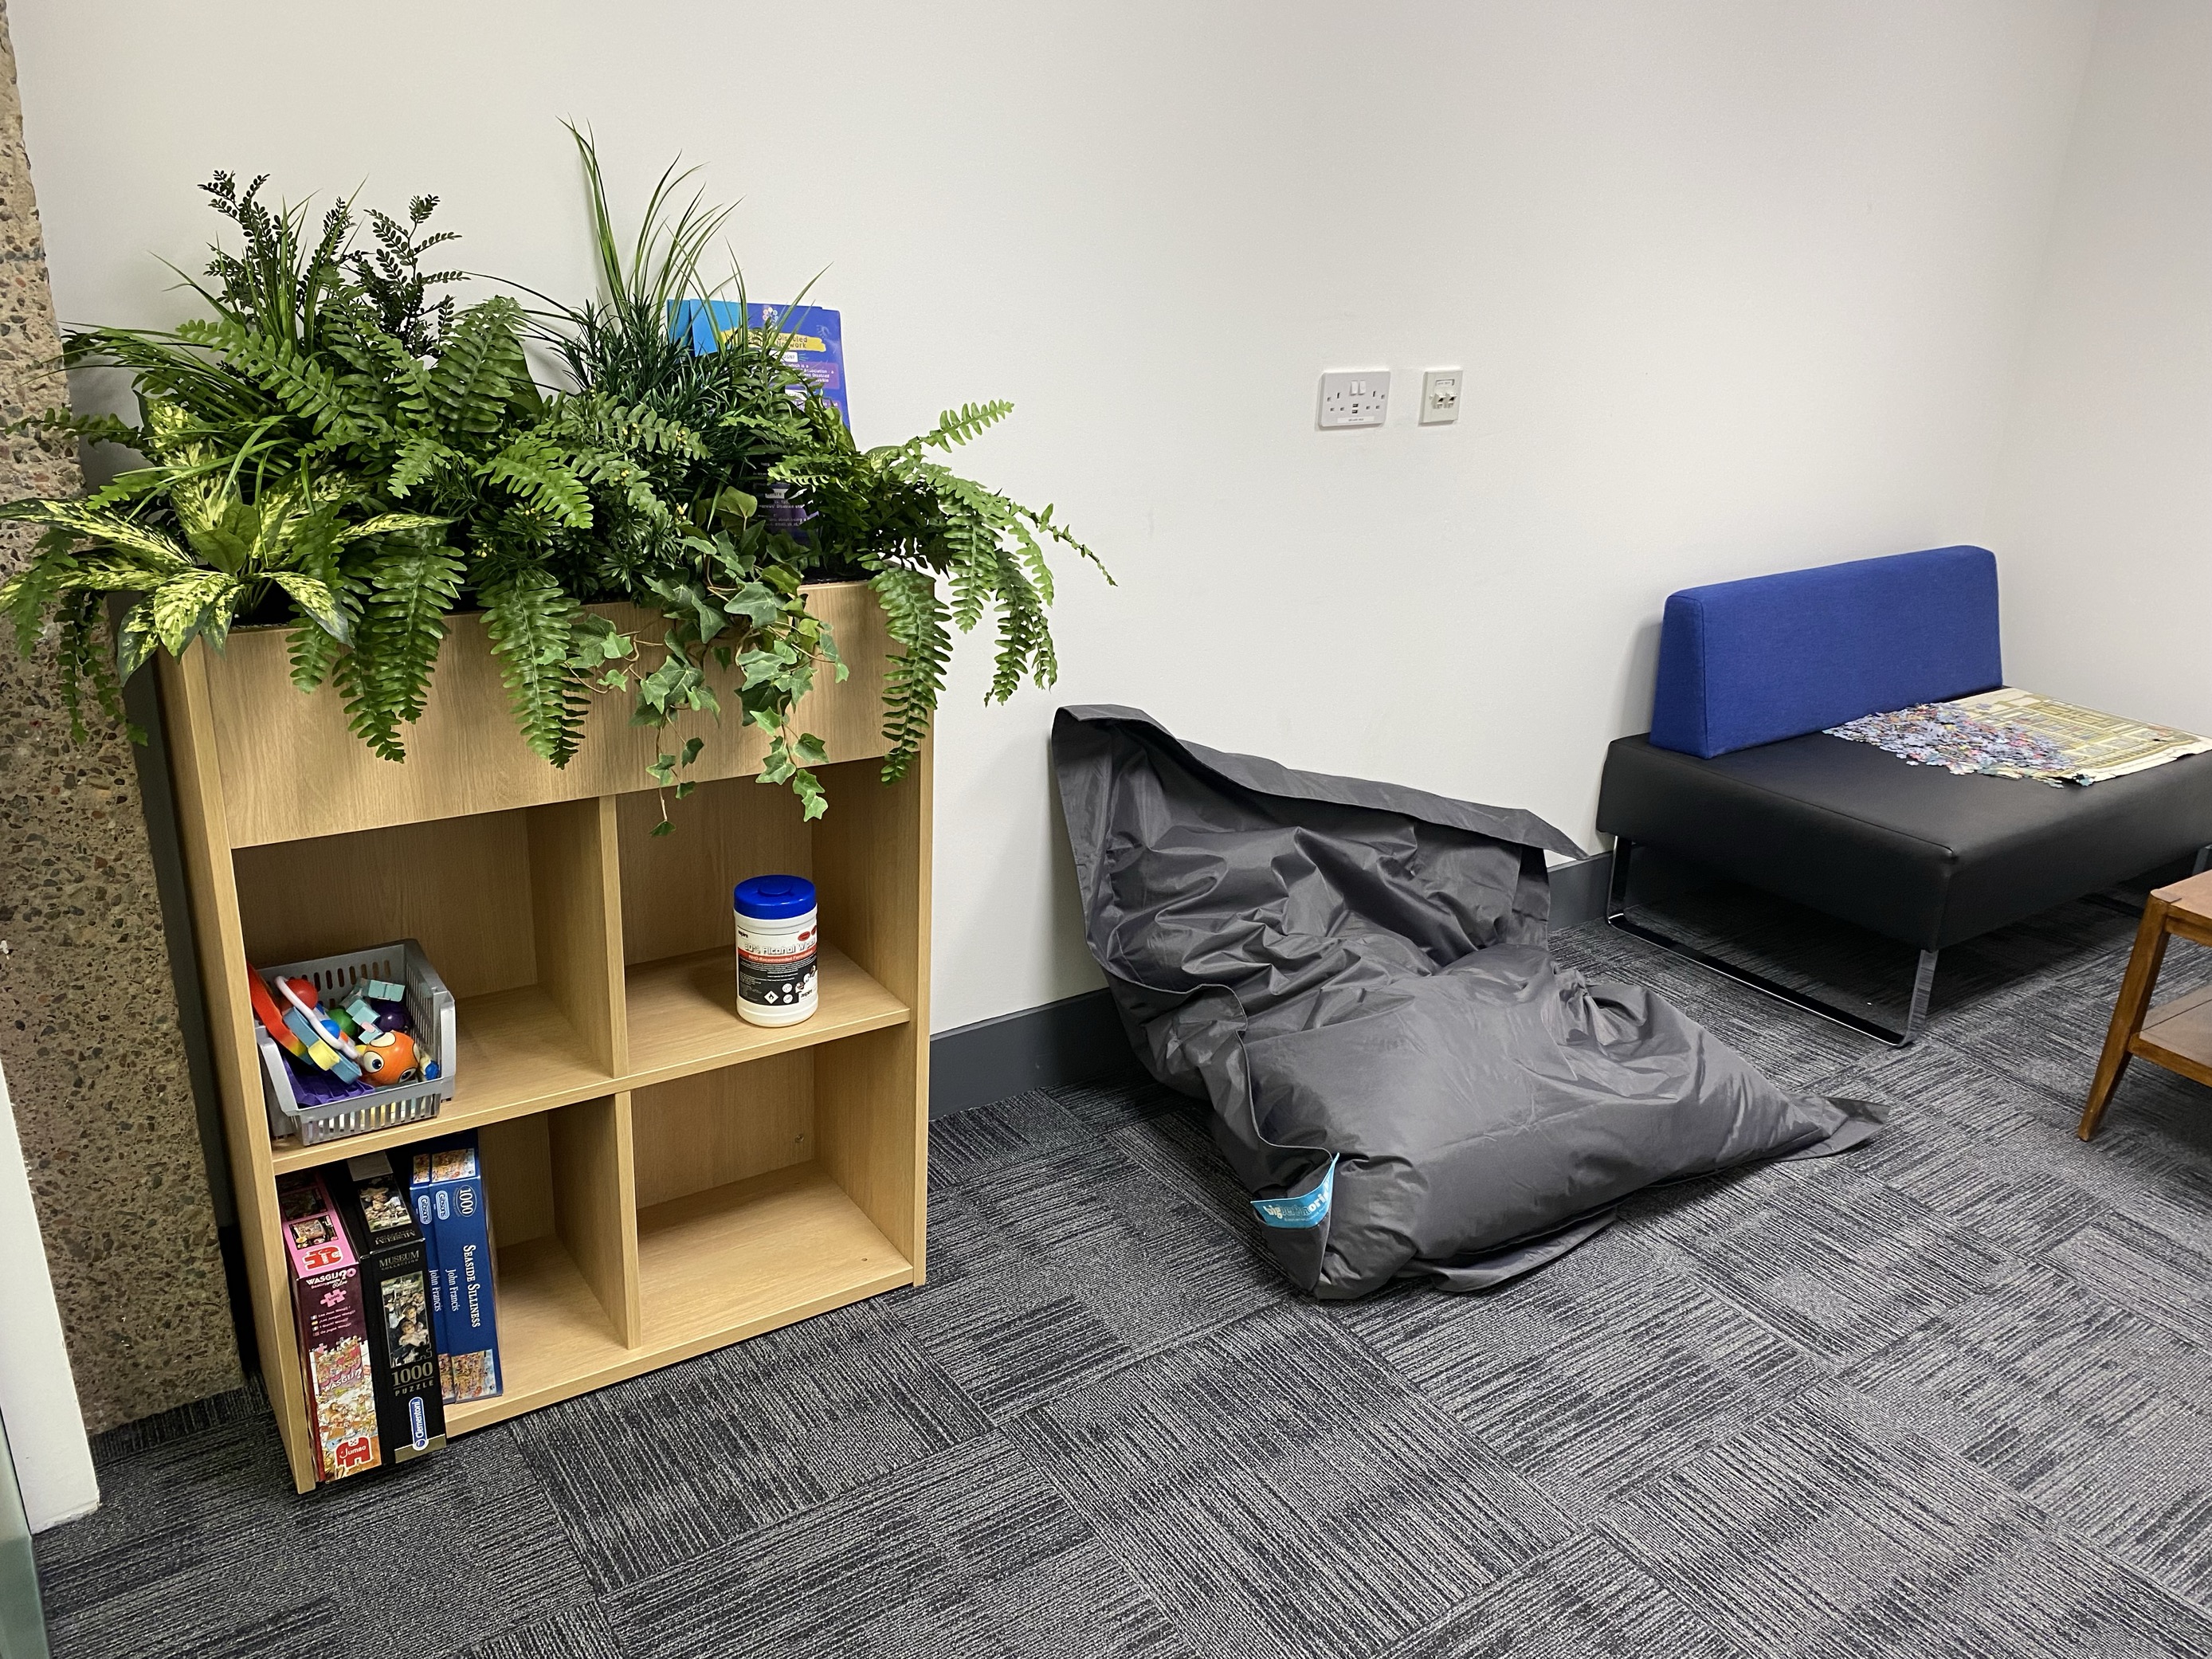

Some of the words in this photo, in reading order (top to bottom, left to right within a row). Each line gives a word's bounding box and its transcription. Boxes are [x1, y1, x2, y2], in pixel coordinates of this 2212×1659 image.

[762, 944, 795, 955] Alcohol
[421, 1198, 429, 1222] Gibsons
[438, 1193, 447, 1218] Gibsons
[459, 1187, 473, 1214] 1000
[378, 1249, 420, 1268] MUSEUM
[429, 1269, 440, 1285] John
[445, 1269, 458, 1285] John
[432, 1286, 442, 1312] Francis
[449, 1286, 461, 1312] Francis
[391, 1361, 433, 1386] 1000
[394, 1379, 434, 1397] PUZZLE
[411, 1400, 425, 1438] Clementoni
[339, 1445, 367, 1459] Jumbo
